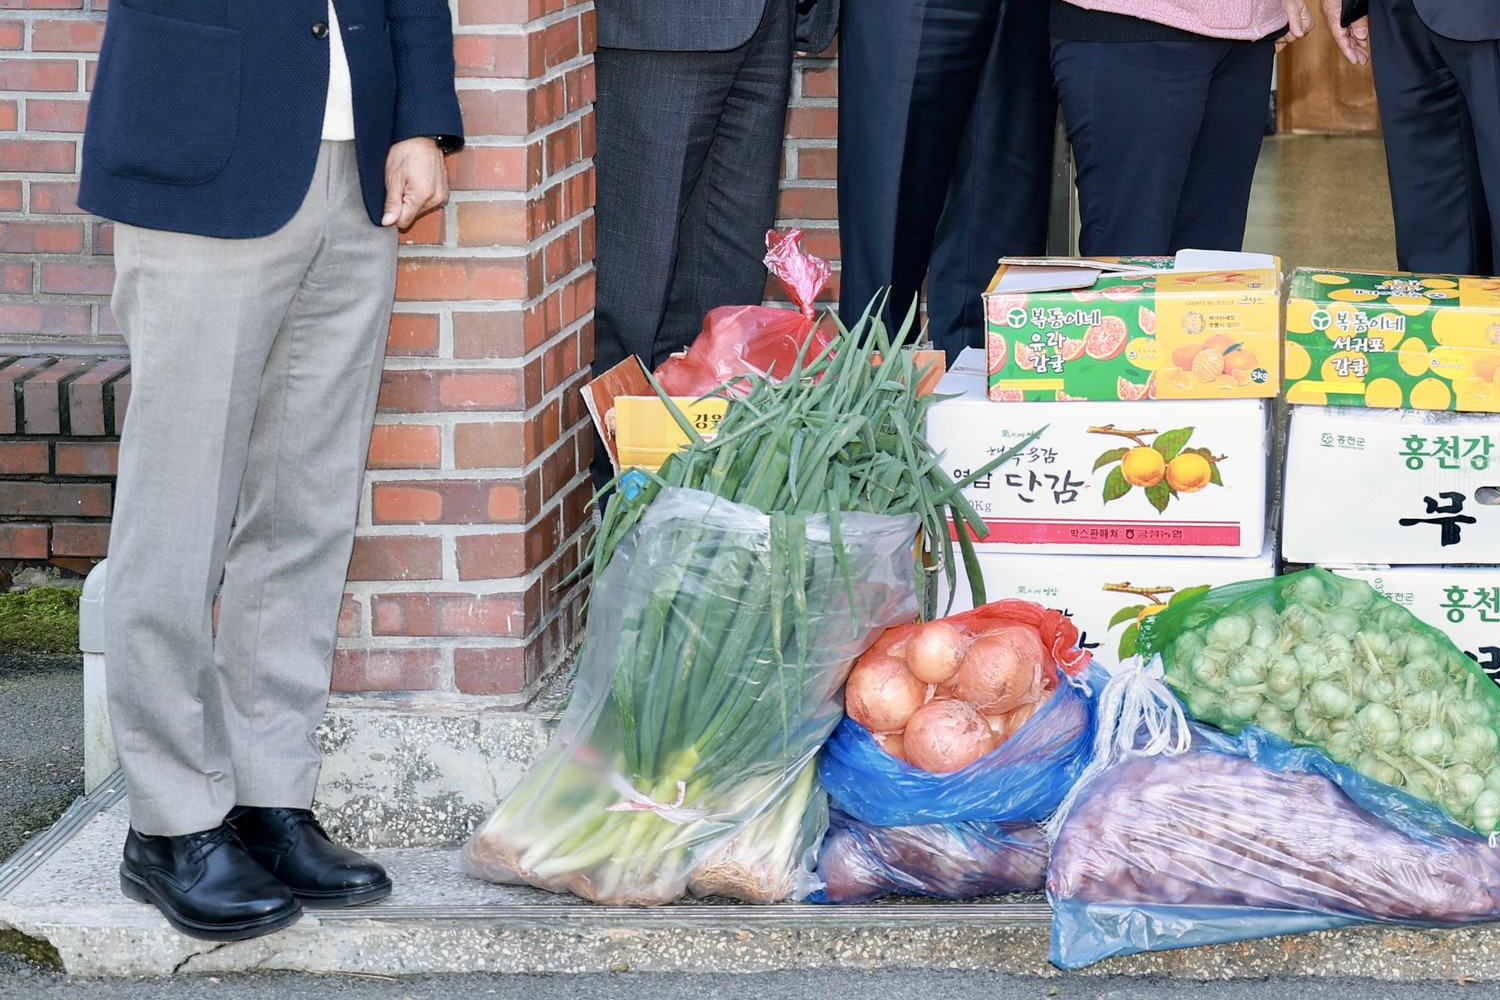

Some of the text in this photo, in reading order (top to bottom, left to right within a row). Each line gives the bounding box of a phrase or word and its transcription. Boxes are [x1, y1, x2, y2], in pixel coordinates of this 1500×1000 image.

[1030, 307, 1101, 330] 복동이네
[1335, 310, 1406, 332] 복동이네
[1029, 331, 1066, 351] 유라
[1332, 336, 1385, 354] 서귀포
[1029, 353, 1066, 375] 감귤
[1332, 356, 1368, 378] 감귤
[1251, 370, 1268, 382] 5kg
[1337, 435, 1365, 447] 홍천군
[1398, 434, 1495, 471] 홍천강
[1005, 469, 1085, 505] 단감
[1399, 491, 1477, 547] 무
[1137, 529, 1182, 539] 금정농협
